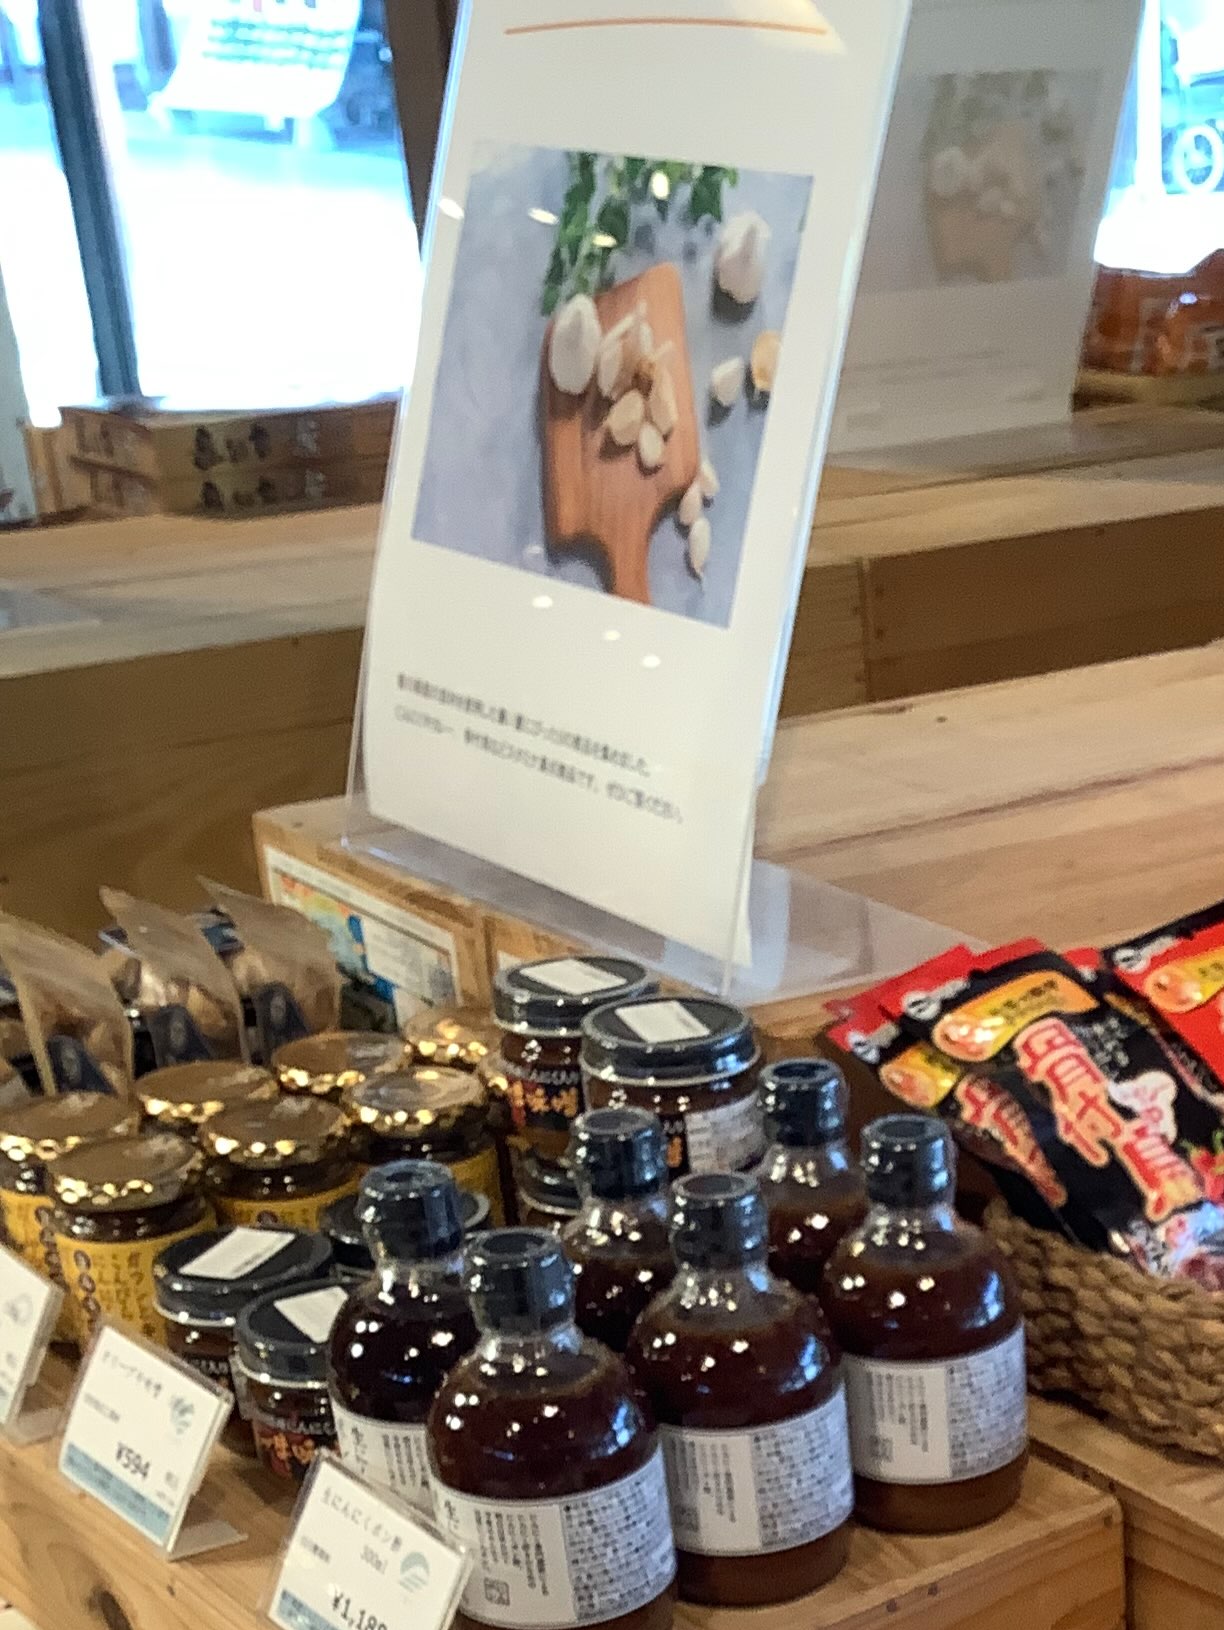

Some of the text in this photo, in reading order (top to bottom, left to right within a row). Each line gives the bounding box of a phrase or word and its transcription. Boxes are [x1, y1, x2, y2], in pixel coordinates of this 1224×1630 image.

[1013, 1016, 1203, 1223] 骨付鳥
[116, 1441, 151, 1480] ¥594
